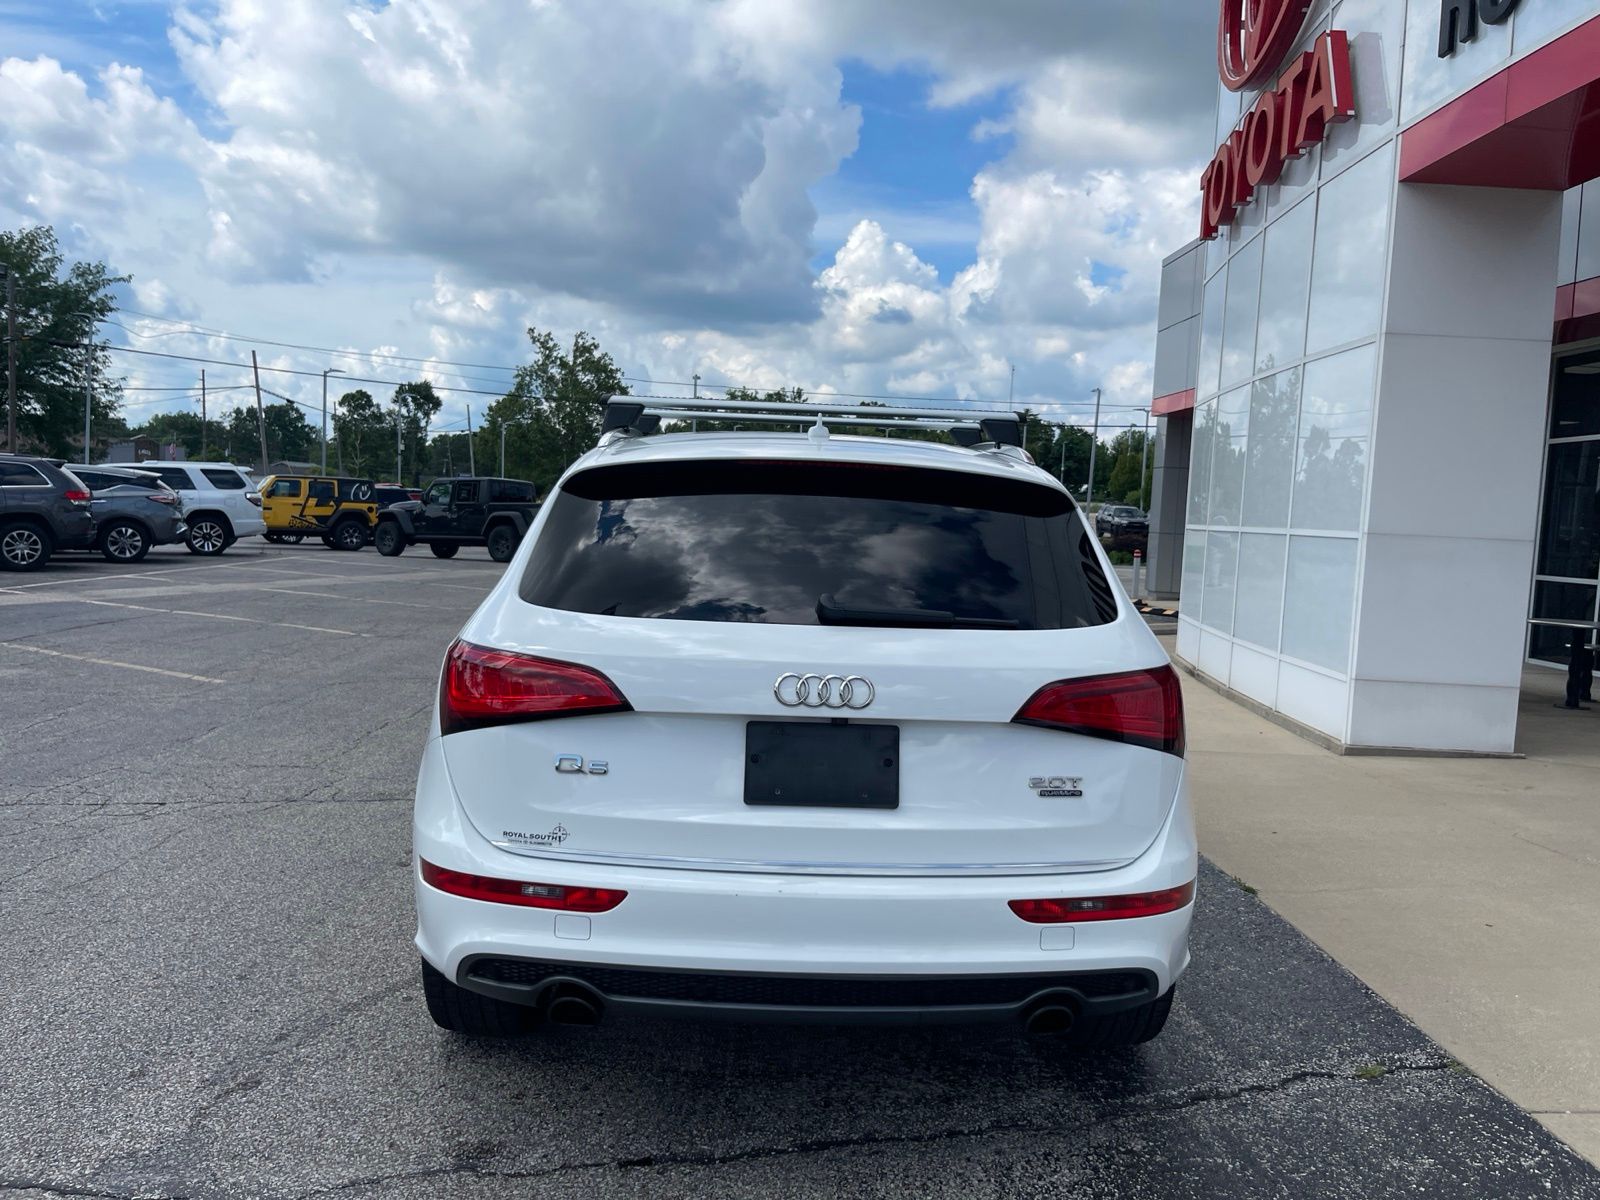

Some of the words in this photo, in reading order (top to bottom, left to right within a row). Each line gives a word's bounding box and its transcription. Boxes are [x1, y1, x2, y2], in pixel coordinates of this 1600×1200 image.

[1200, 30, 1354, 240] TOYOTA
[555, 754, 608, 775] Q5
[502, 830, 528, 839] ROYAL
[529, 833, 558, 841] SOUTH
